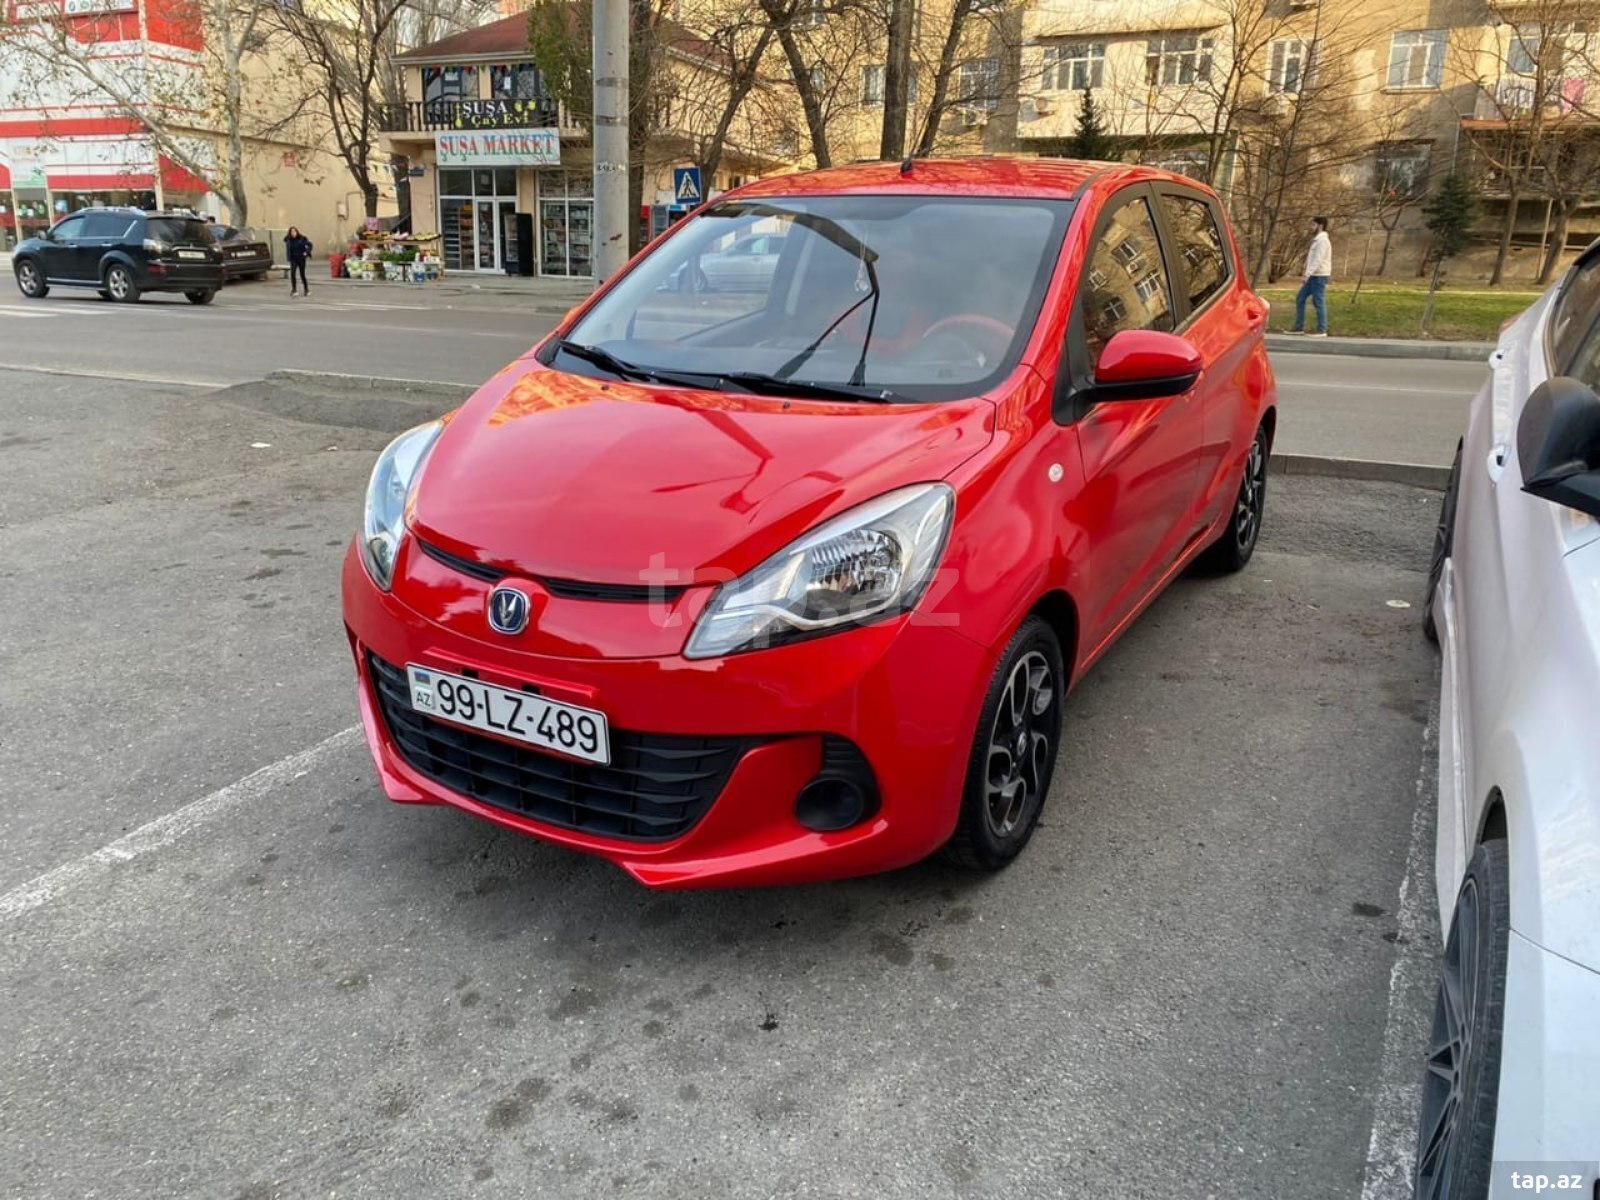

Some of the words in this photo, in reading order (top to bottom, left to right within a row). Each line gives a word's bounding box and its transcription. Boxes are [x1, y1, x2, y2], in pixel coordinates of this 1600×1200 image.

[462, 101, 507, 118] ŞUŞA
[471, 115, 497, 127] Çay
[440, 134, 479, 161] ŞUŞA
[483, 133, 554, 155] MARKET
[416, 691, 431, 707] AZ
[437, 679, 598, 754] 99-LZ-489
